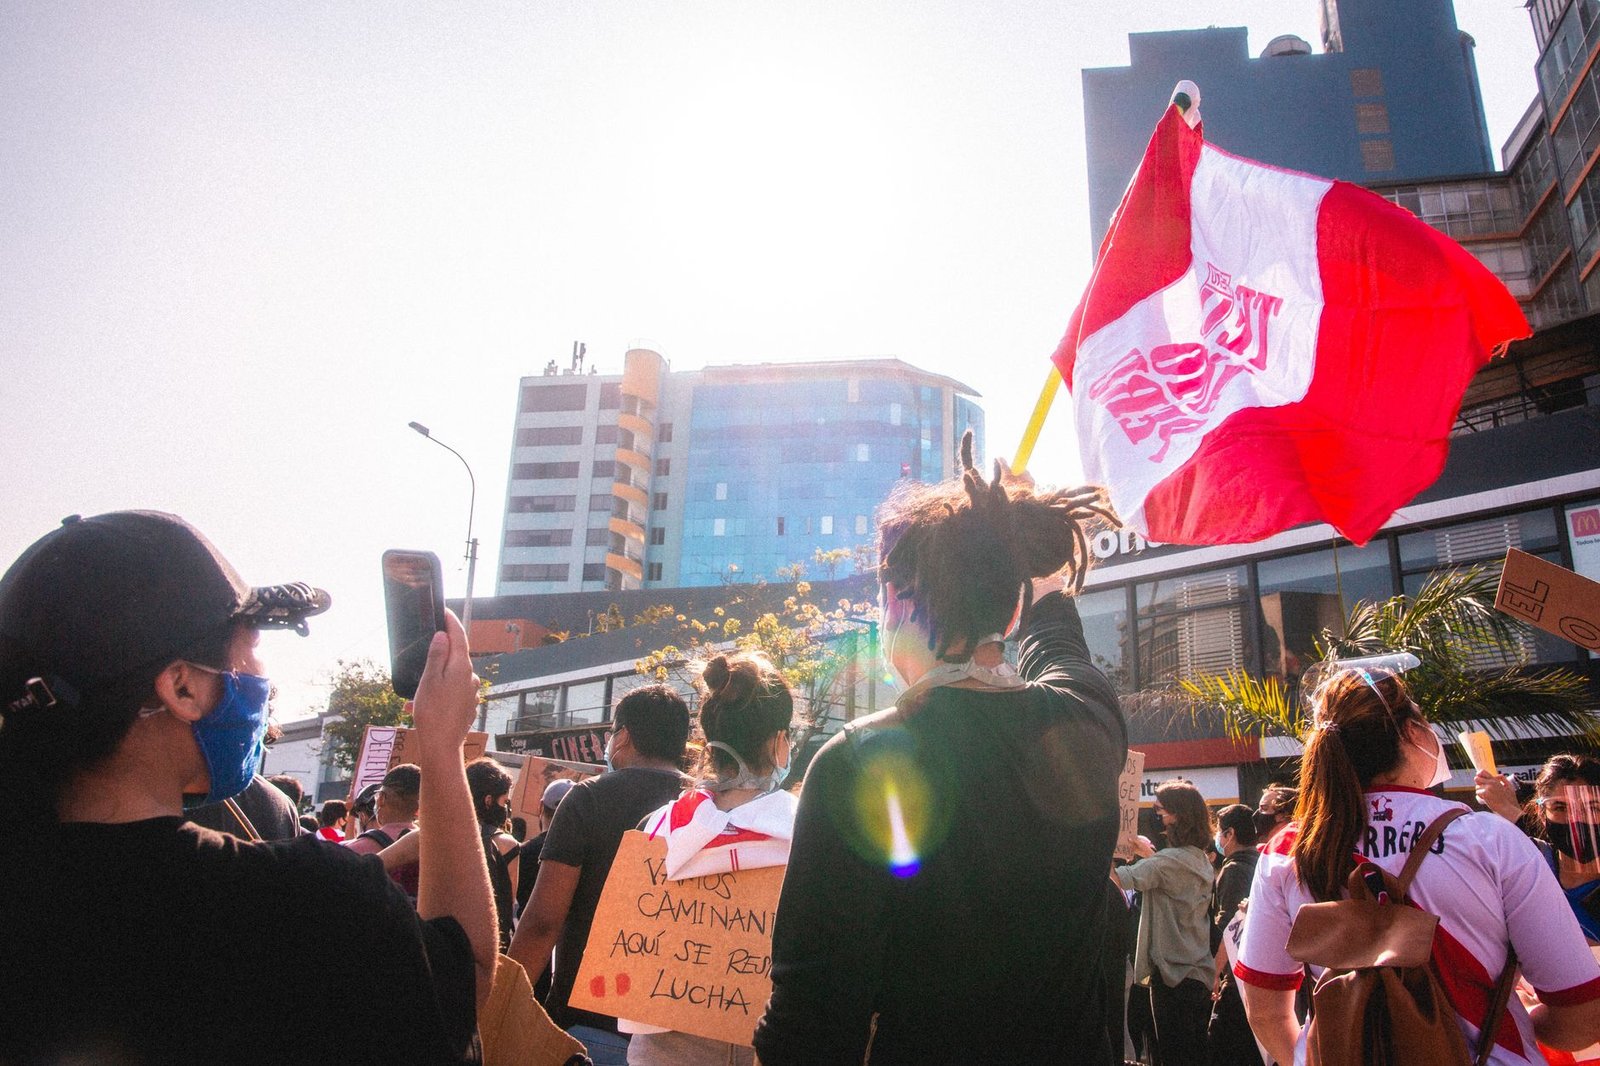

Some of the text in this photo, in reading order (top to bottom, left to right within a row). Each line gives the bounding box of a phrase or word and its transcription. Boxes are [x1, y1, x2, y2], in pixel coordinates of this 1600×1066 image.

[609, 929, 772, 979] AQUÍ SE RES
[650, 969, 751, 1016] LUCHA
